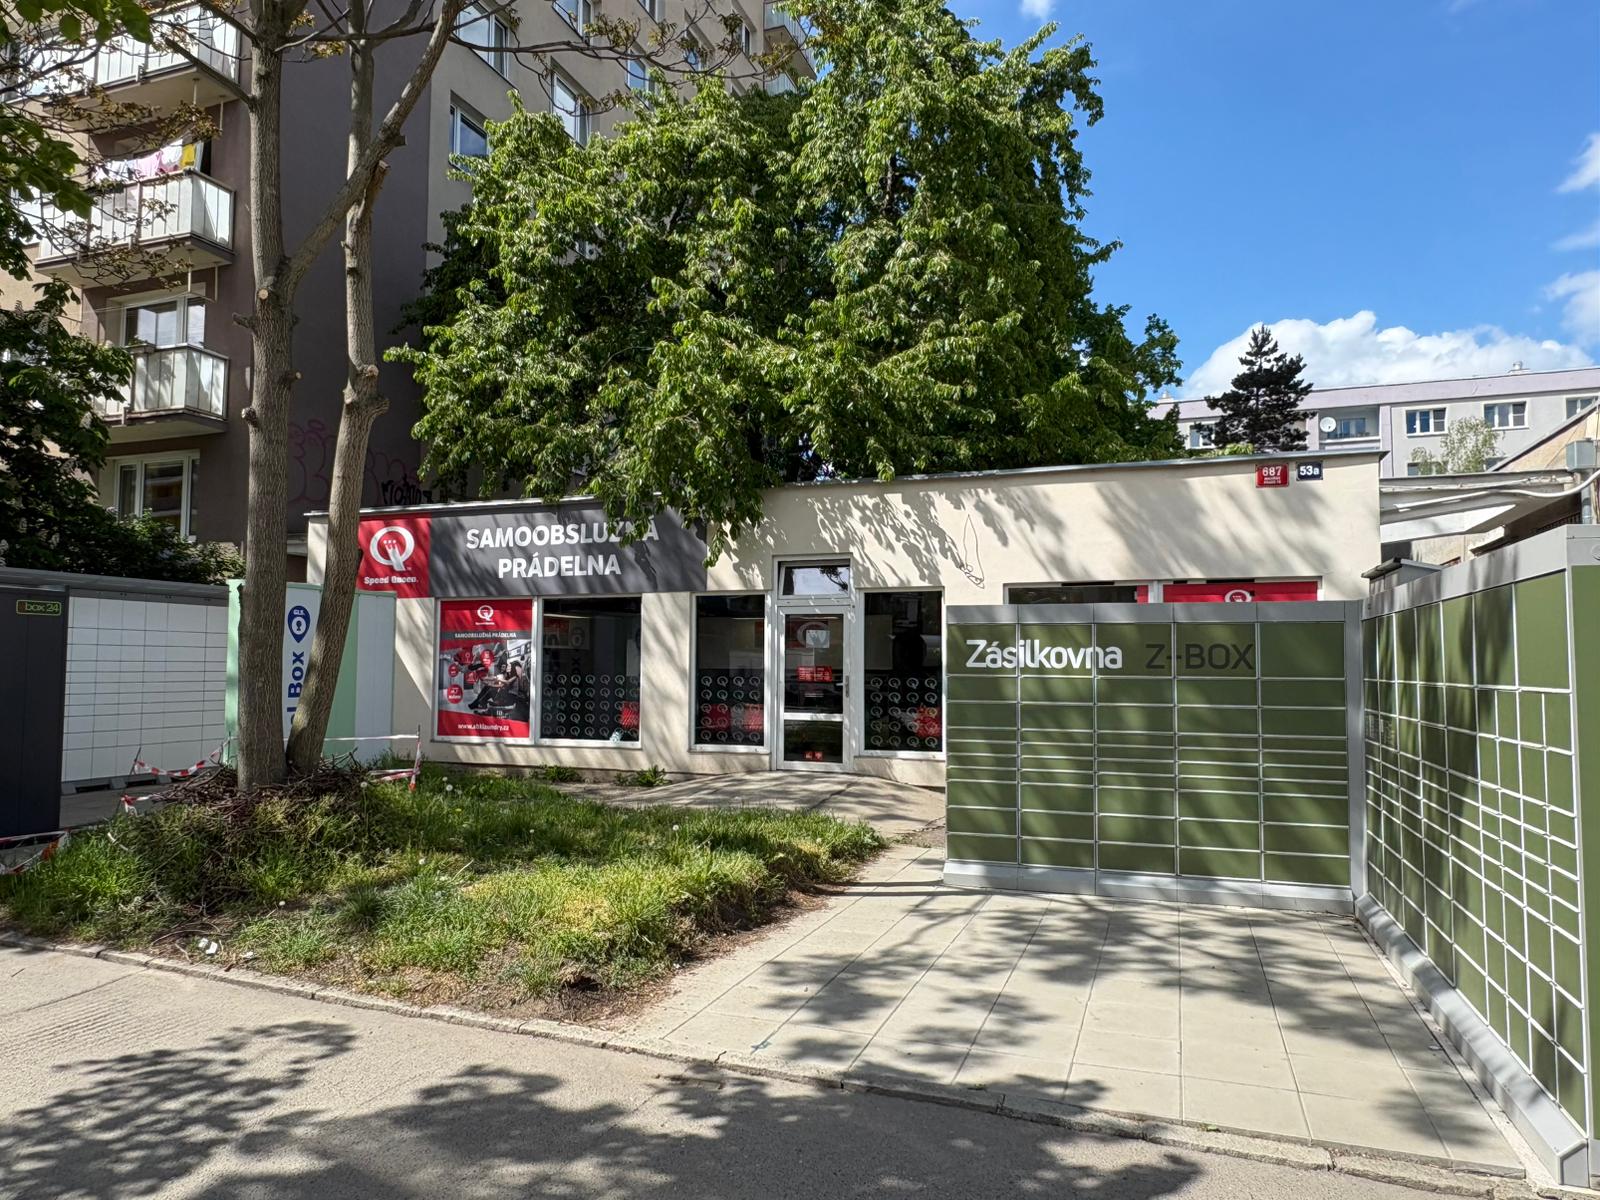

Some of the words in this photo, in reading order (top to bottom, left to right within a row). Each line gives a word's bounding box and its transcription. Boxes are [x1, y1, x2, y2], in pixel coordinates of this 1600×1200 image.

[1262, 466, 1282, 476] 687
[1299, 465, 1320, 476] 53a
[498, 552, 621, 578] PRÁDELNA
[364, 576, 389, 586] Speed
[391, 576, 416, 584] Queen
[965, 639, 1123, 669] Zásilkovna
[1145, 643, 1254, 669] Z-BOX
